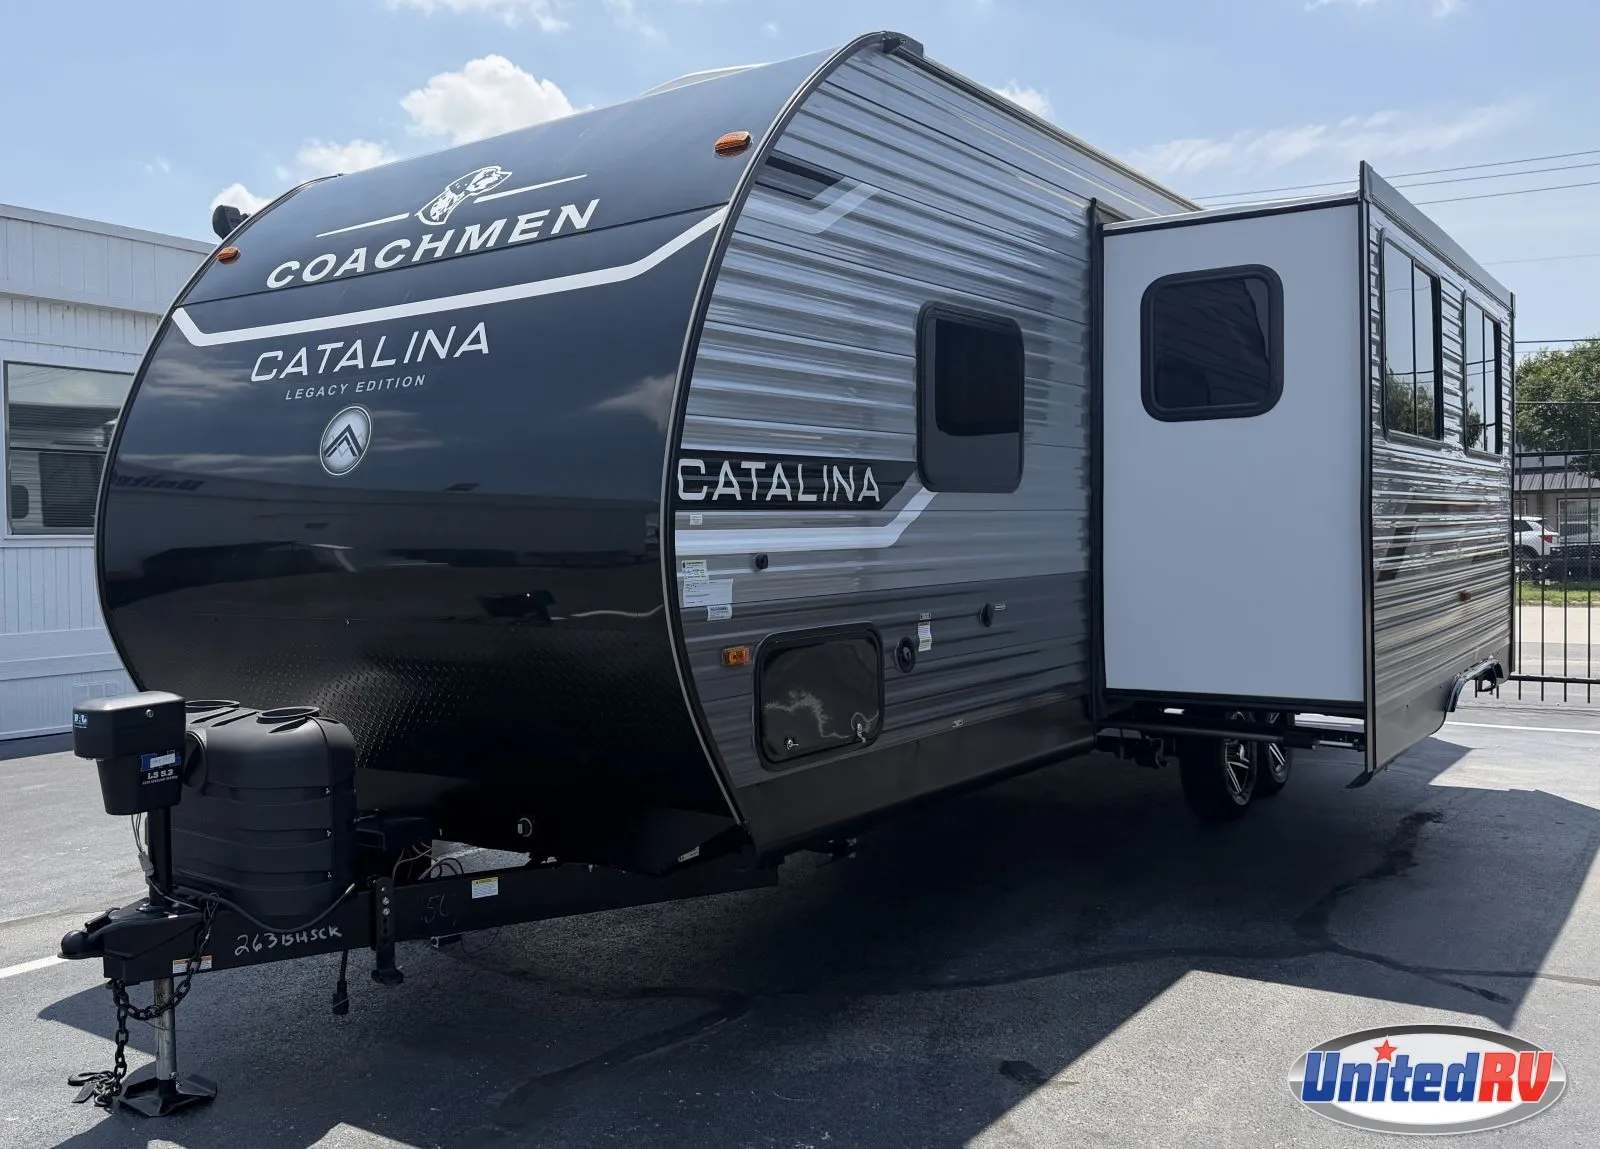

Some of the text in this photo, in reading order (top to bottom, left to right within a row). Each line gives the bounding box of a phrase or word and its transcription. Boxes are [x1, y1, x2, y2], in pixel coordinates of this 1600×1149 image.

[266, 199, 600, 289] COACHMEN
[250, 321, 490, 382] CATALINA
[285, 374, 426, 401] LEGACY EDITION
[677, 458, 881, 502] CATALINA
